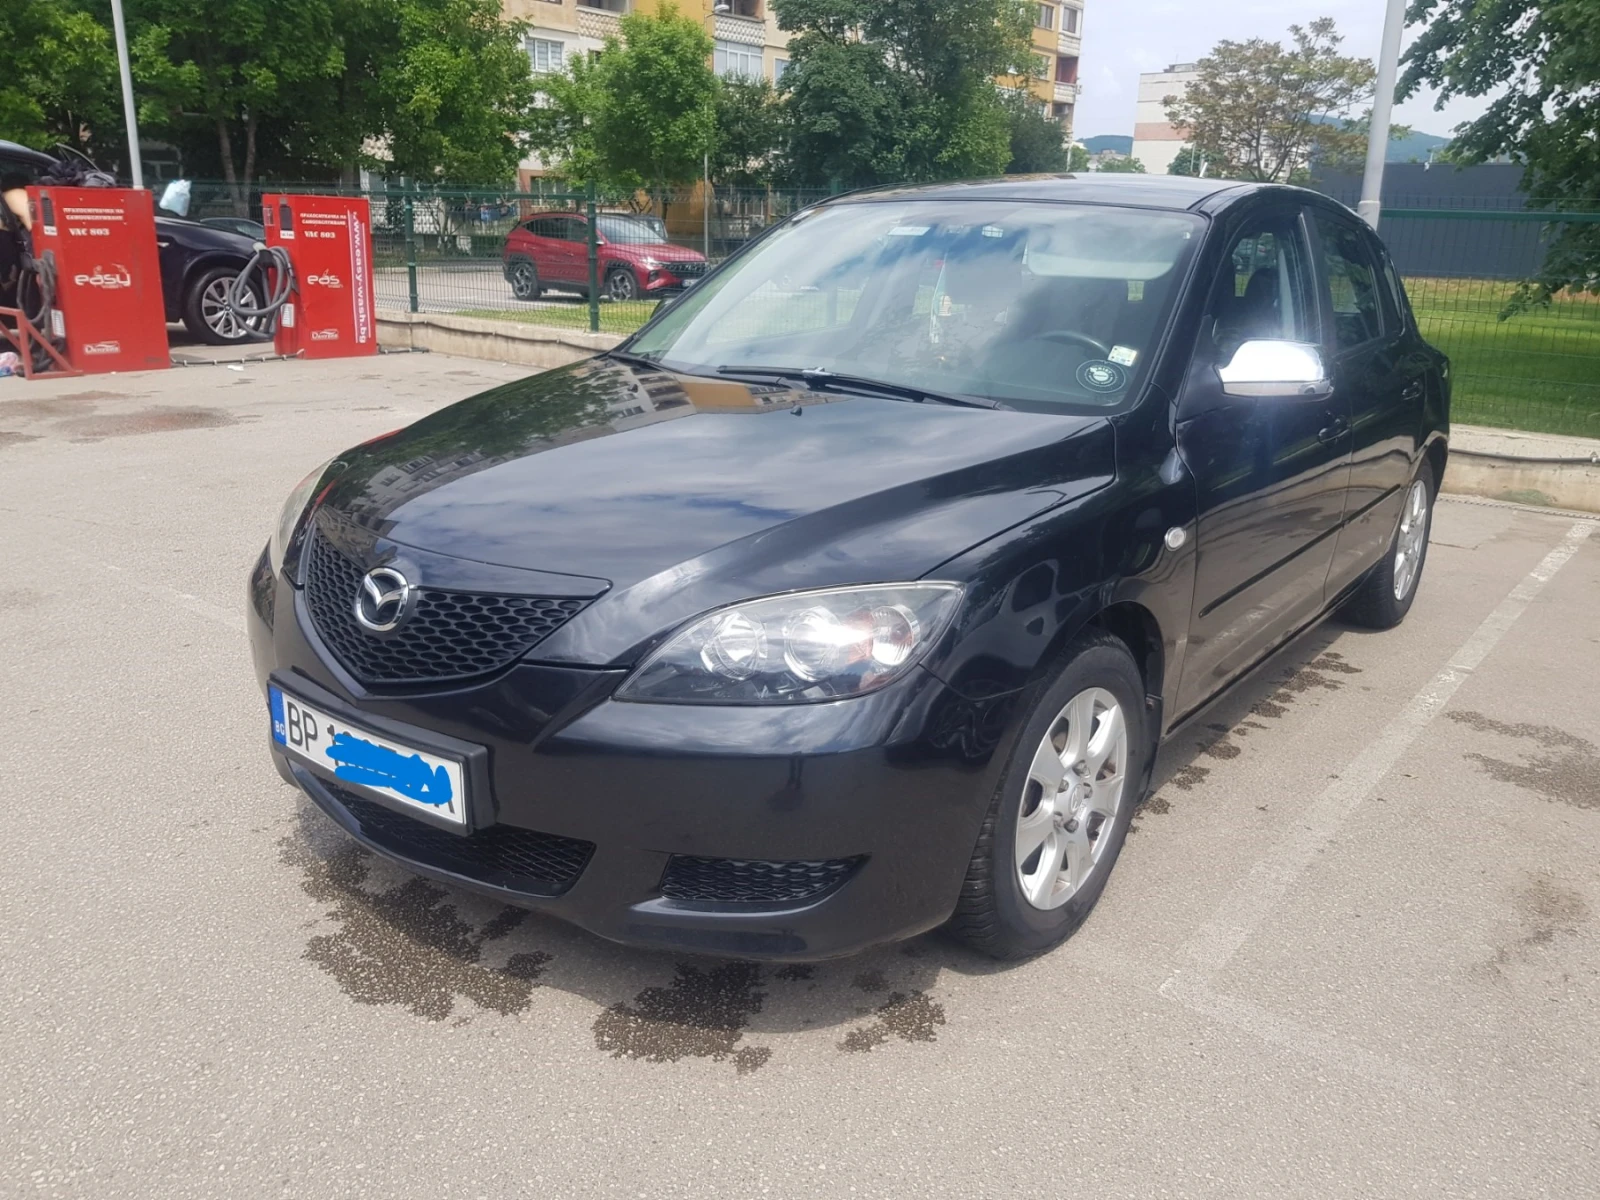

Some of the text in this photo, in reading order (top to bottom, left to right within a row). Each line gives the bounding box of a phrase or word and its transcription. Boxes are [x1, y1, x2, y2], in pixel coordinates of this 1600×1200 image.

[68, 228, 110, 236] VAC 803
[304, 230, 336, 239] VAC 803
[274, 719, 287, 737] BG
[287, 701, 318, 753] BP
